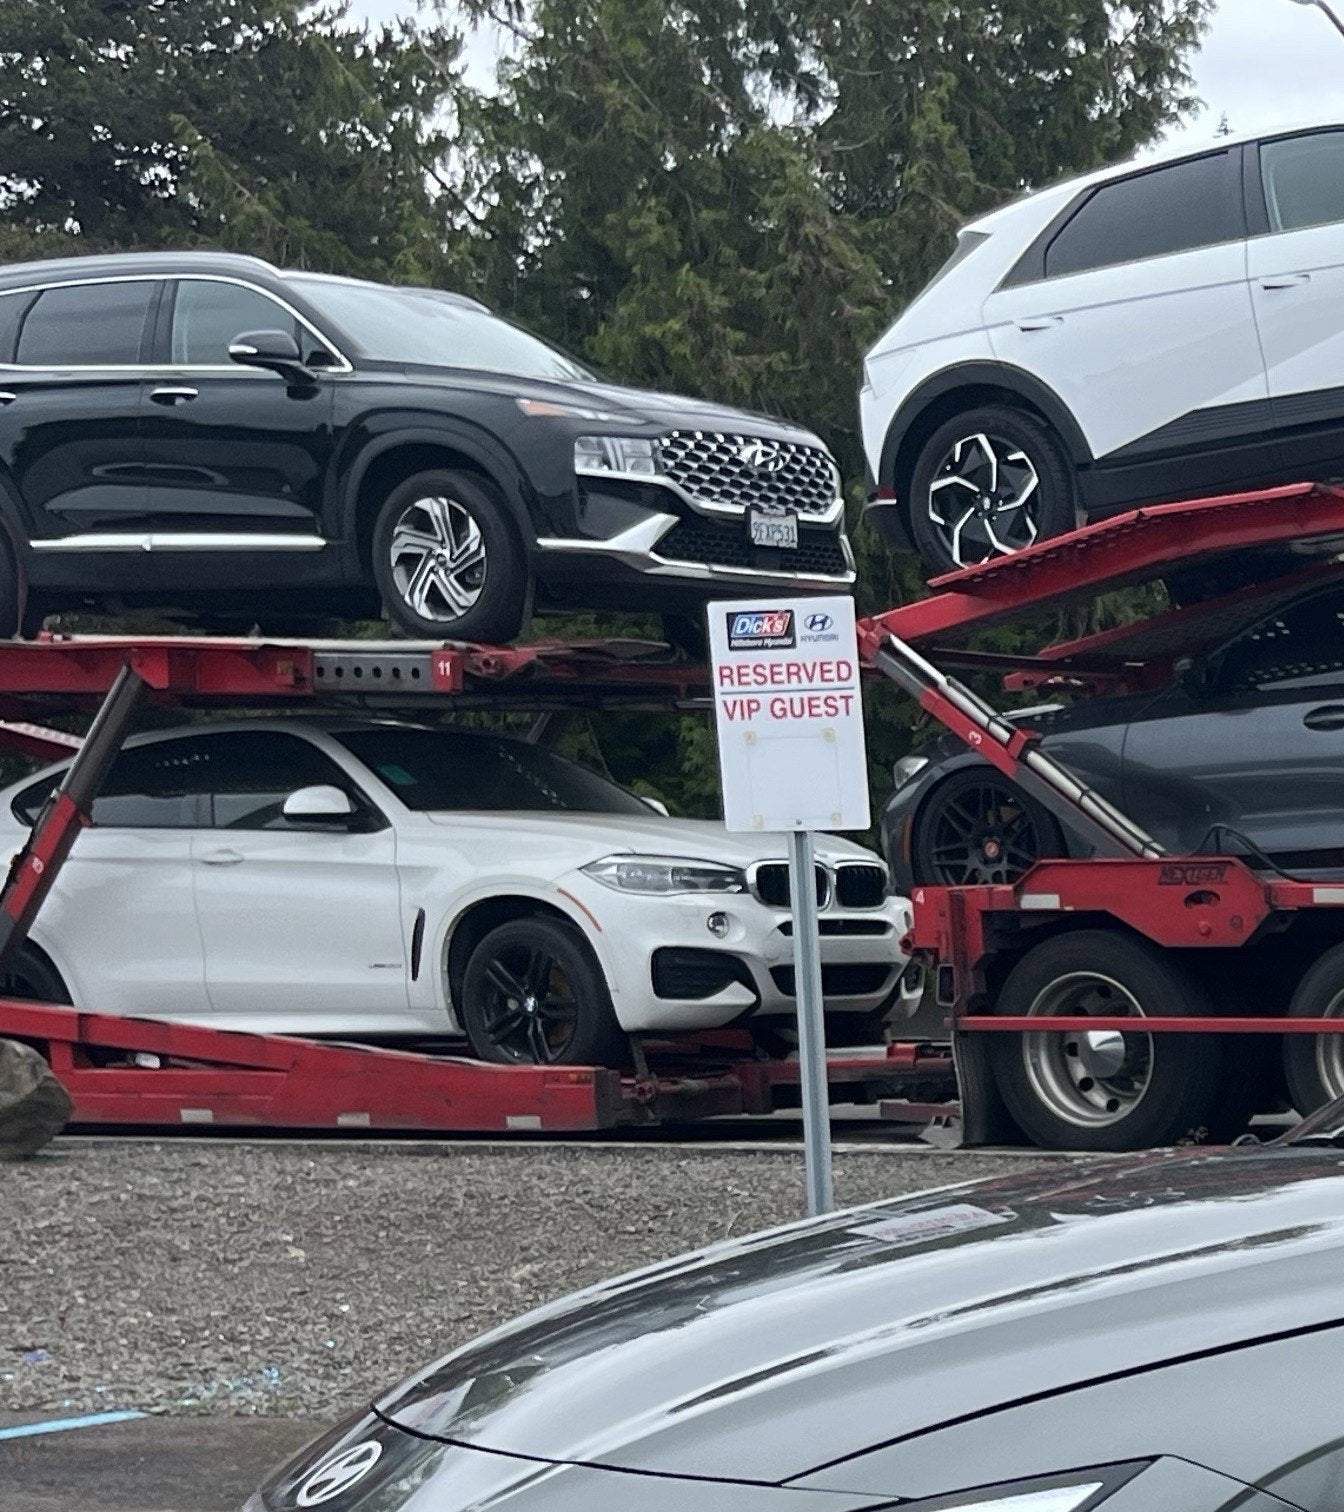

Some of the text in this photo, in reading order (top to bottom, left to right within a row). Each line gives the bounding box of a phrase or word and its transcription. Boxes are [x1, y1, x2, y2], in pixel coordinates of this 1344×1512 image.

[719, 660, 853, 687] RESERVED
[722, 694, 854, 721] VIP GUEST
